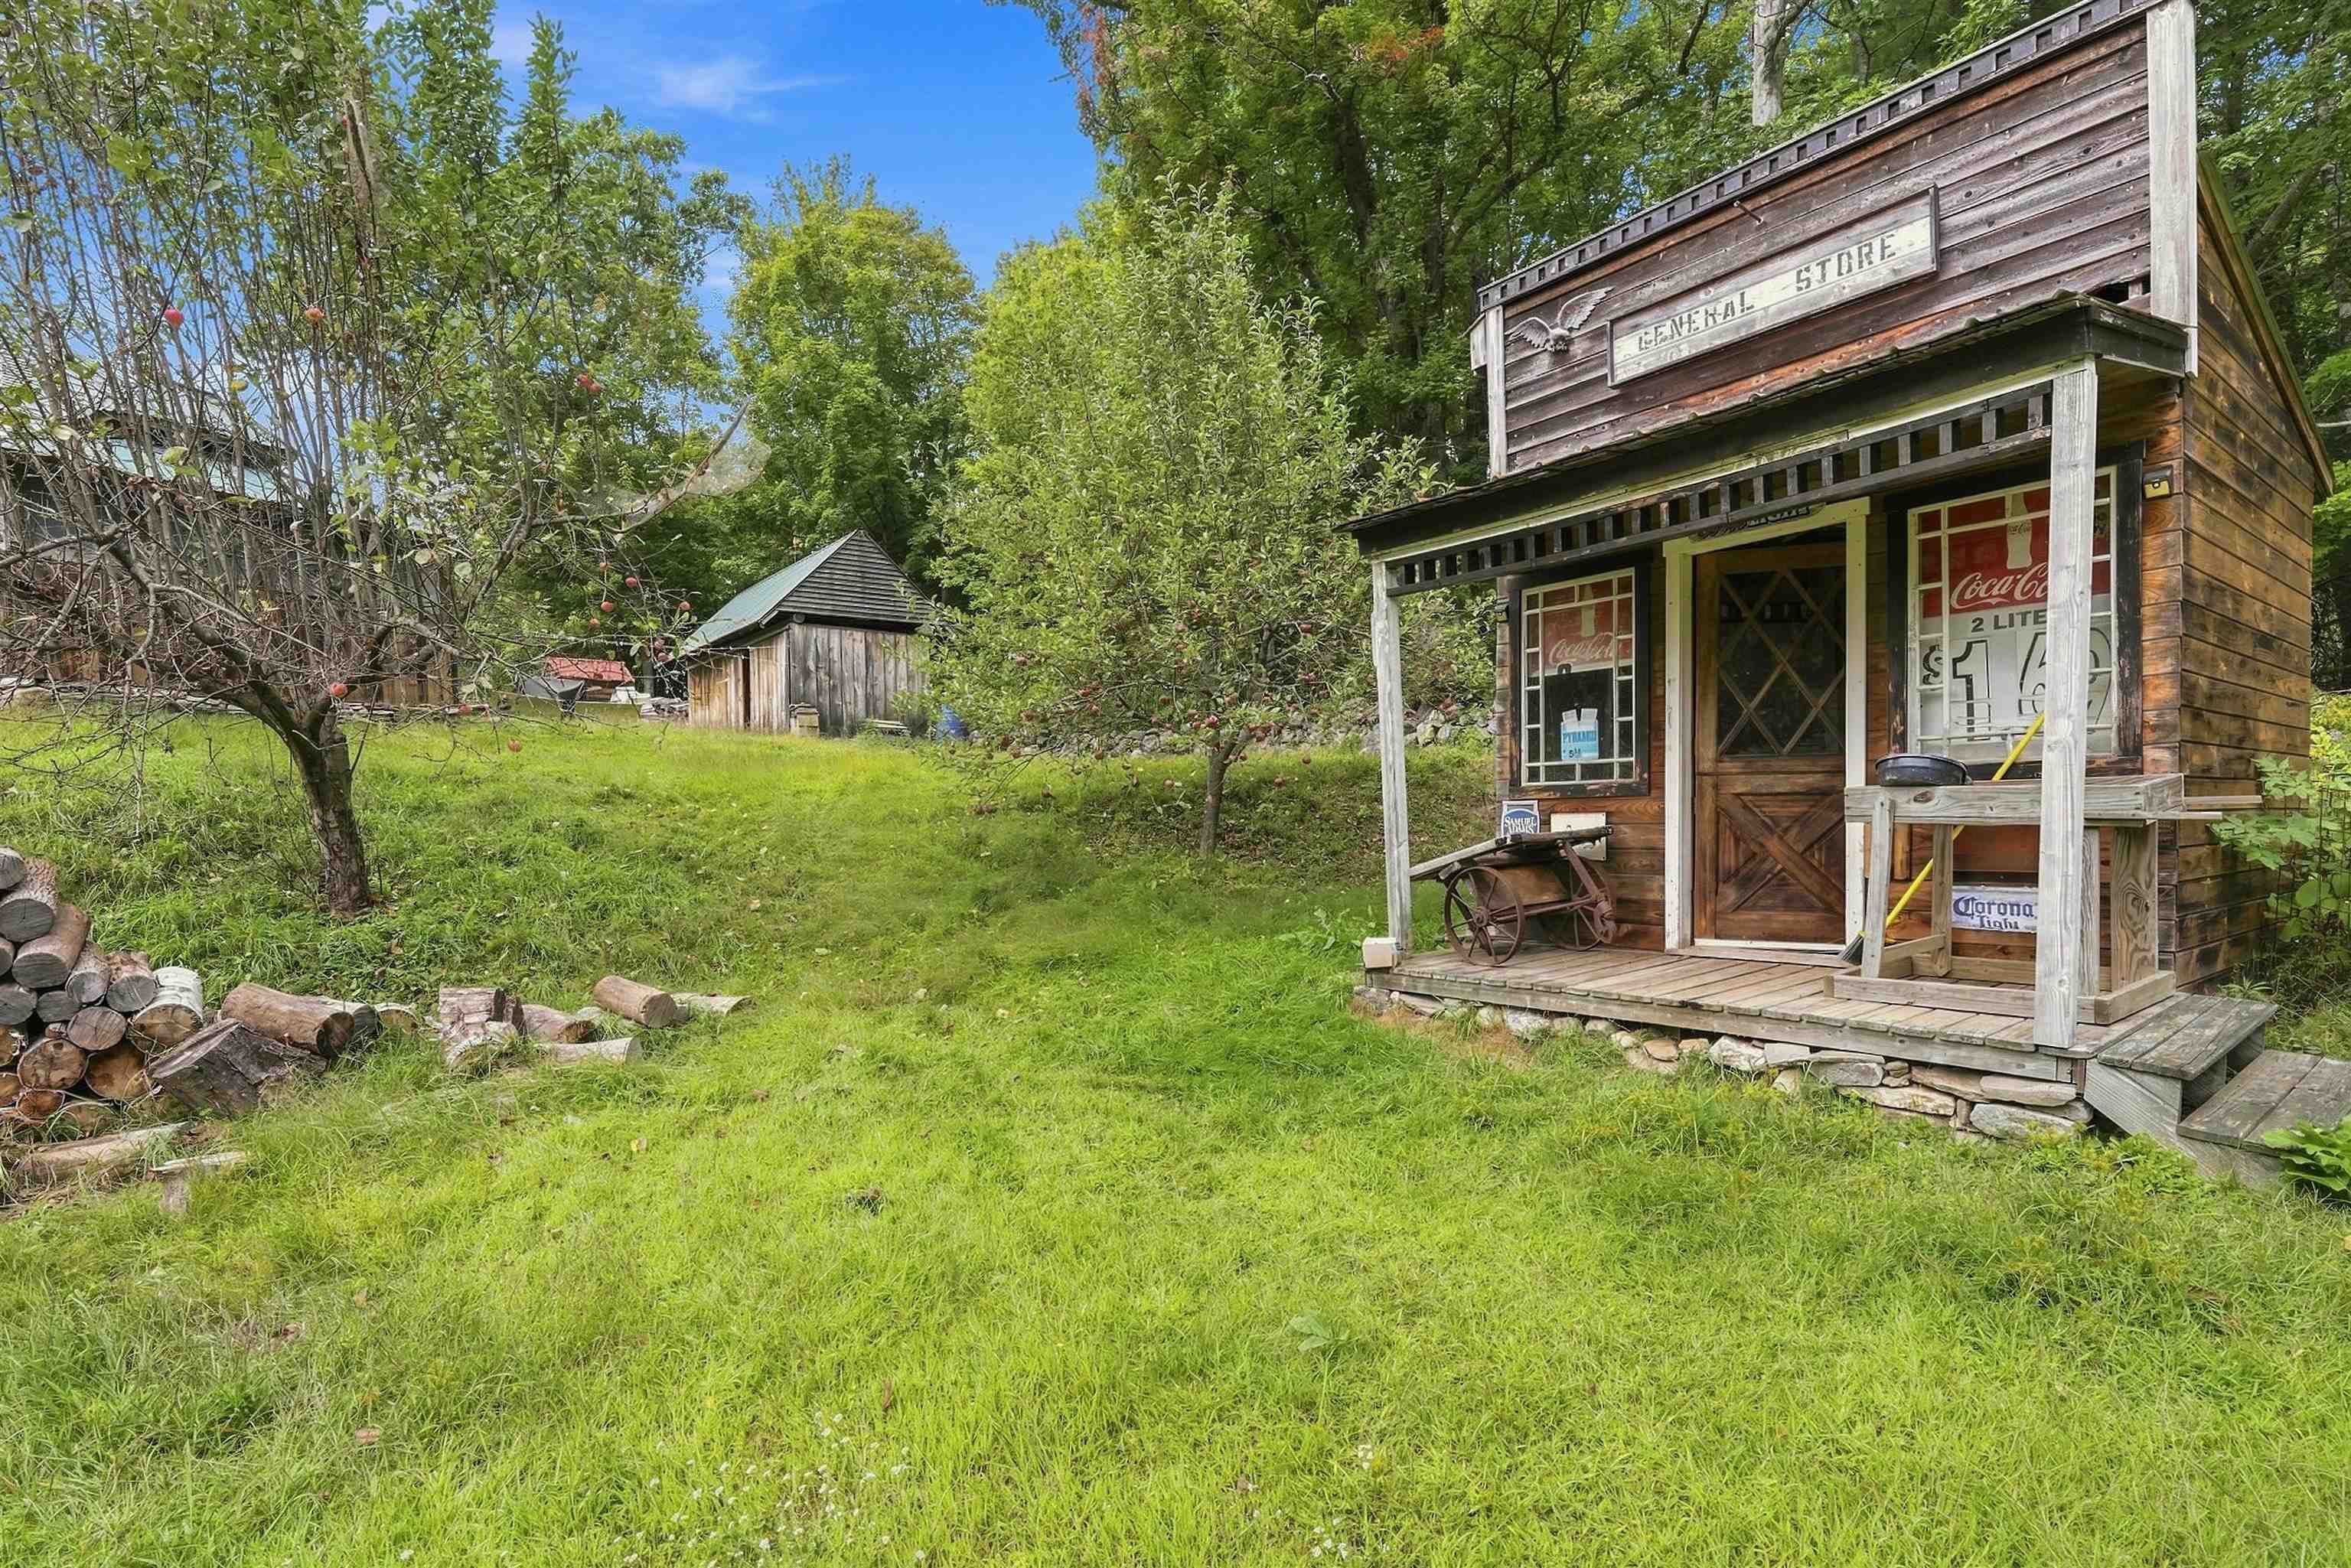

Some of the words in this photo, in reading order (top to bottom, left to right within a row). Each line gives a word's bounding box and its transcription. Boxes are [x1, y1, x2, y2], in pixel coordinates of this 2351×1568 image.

[1638, 291, 1755, 351] GENERAL
[1795, 233, 1896, 292] STORE
[1951, 561, 2049, 609] Coca-Co
[1971, 617, 1984, 633] 2
[1993, 608, 2047, 630] LITE
[1952, 895, 2034, 919] Corona
